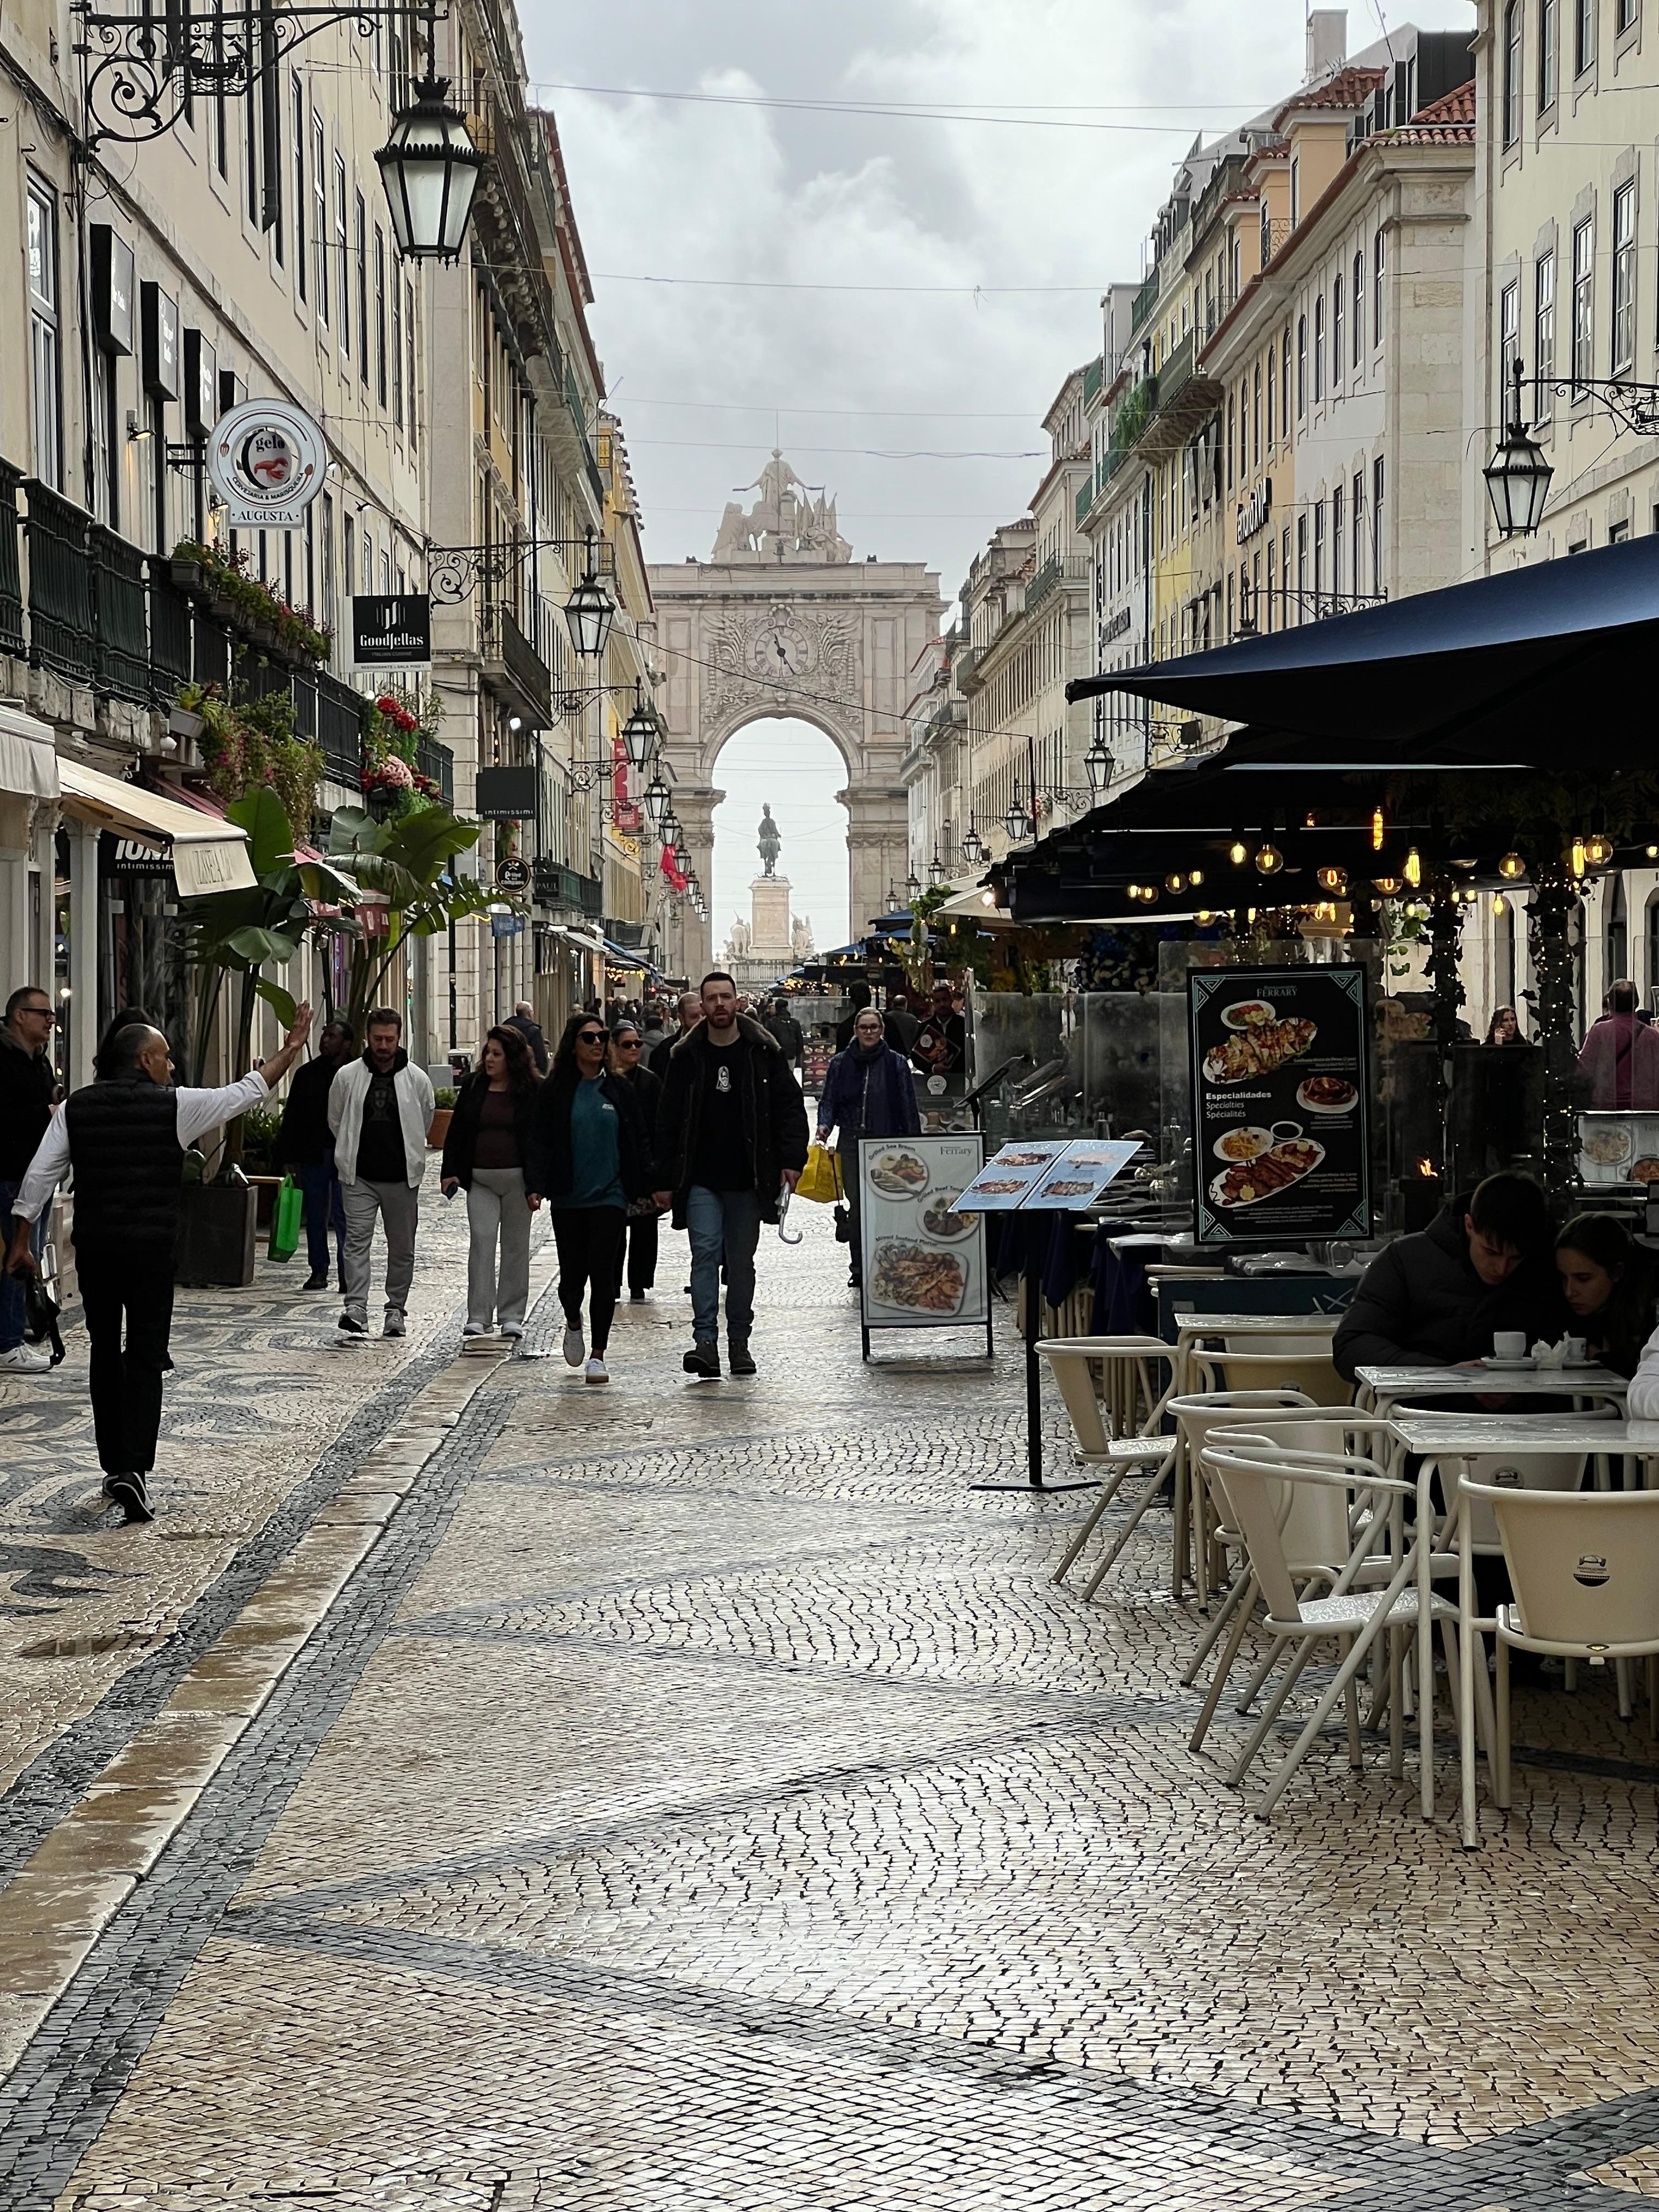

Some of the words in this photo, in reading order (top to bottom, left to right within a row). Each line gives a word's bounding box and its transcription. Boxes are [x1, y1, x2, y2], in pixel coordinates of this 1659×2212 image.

[256, 435, 285, 452] gelo
[232, 476, 264, 500] CERVEJARIA
[270, 472, 304, 500] MARISQUEIRA
[238, 511, 293, 521] AUGUSTA
[360, 633, 424, 650] Goodfellas
[1257, 988, 1297, 997] FERRARY
[1206, 1091, 1272, 1101] Especialidades
[1206, 1101, 1244, 1110] Specialties
[1206, 1110, 1246, 1120] Spécialités
[868, 1146, 885, 1160] Grilled
